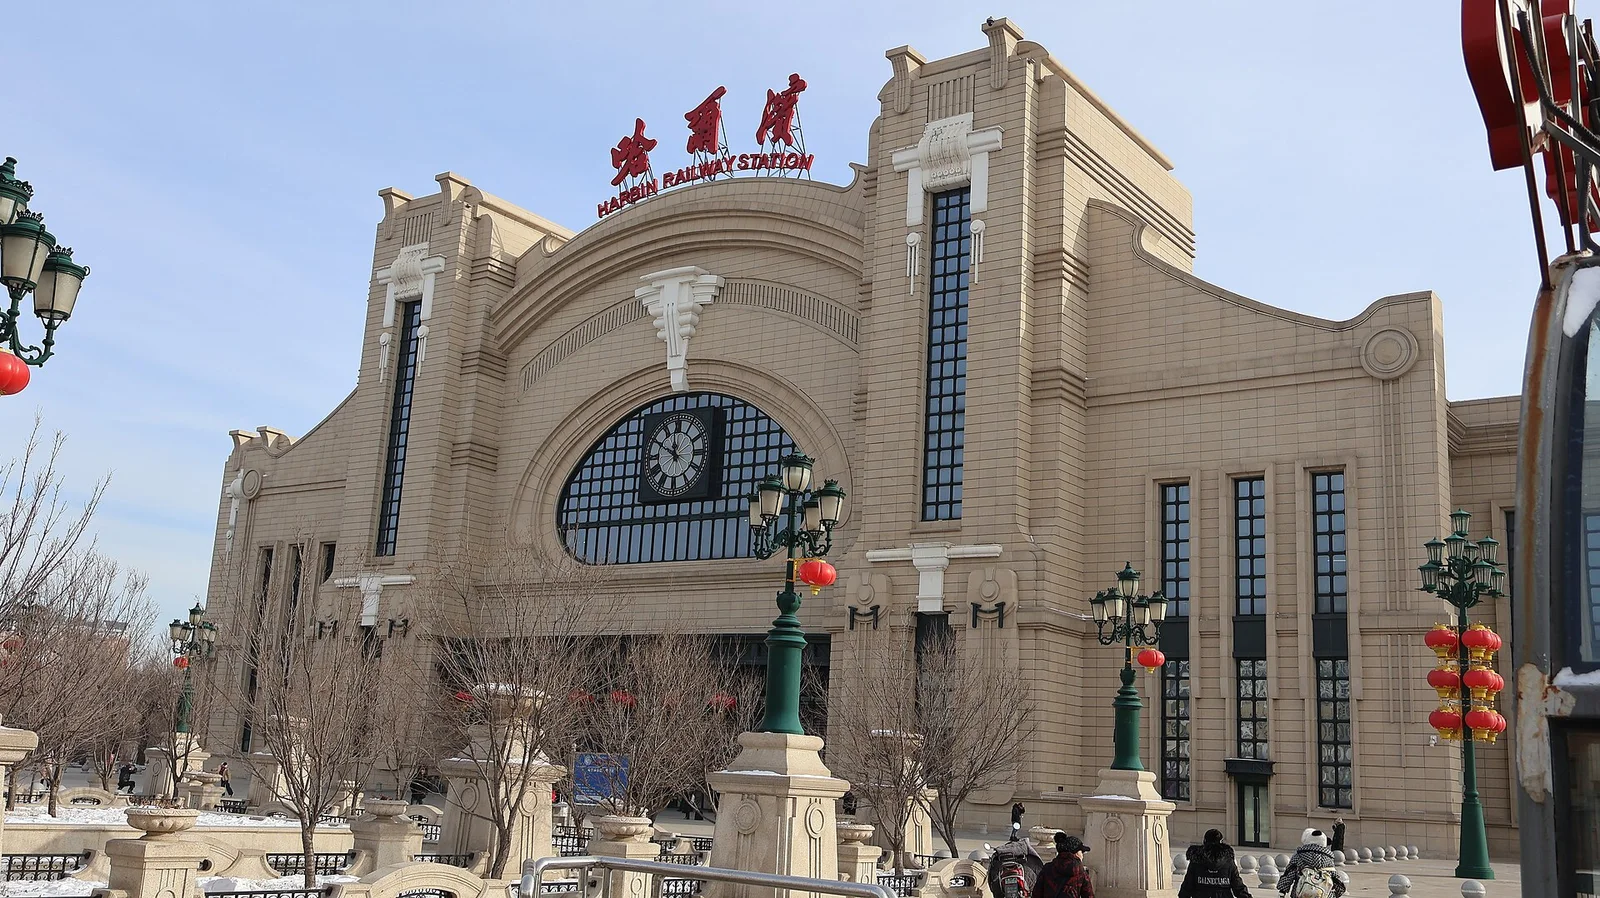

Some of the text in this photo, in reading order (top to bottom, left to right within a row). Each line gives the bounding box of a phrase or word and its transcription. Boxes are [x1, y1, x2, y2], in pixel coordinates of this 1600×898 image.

[597, 152, 815, 218] HARBIN RAILWAY STATION
